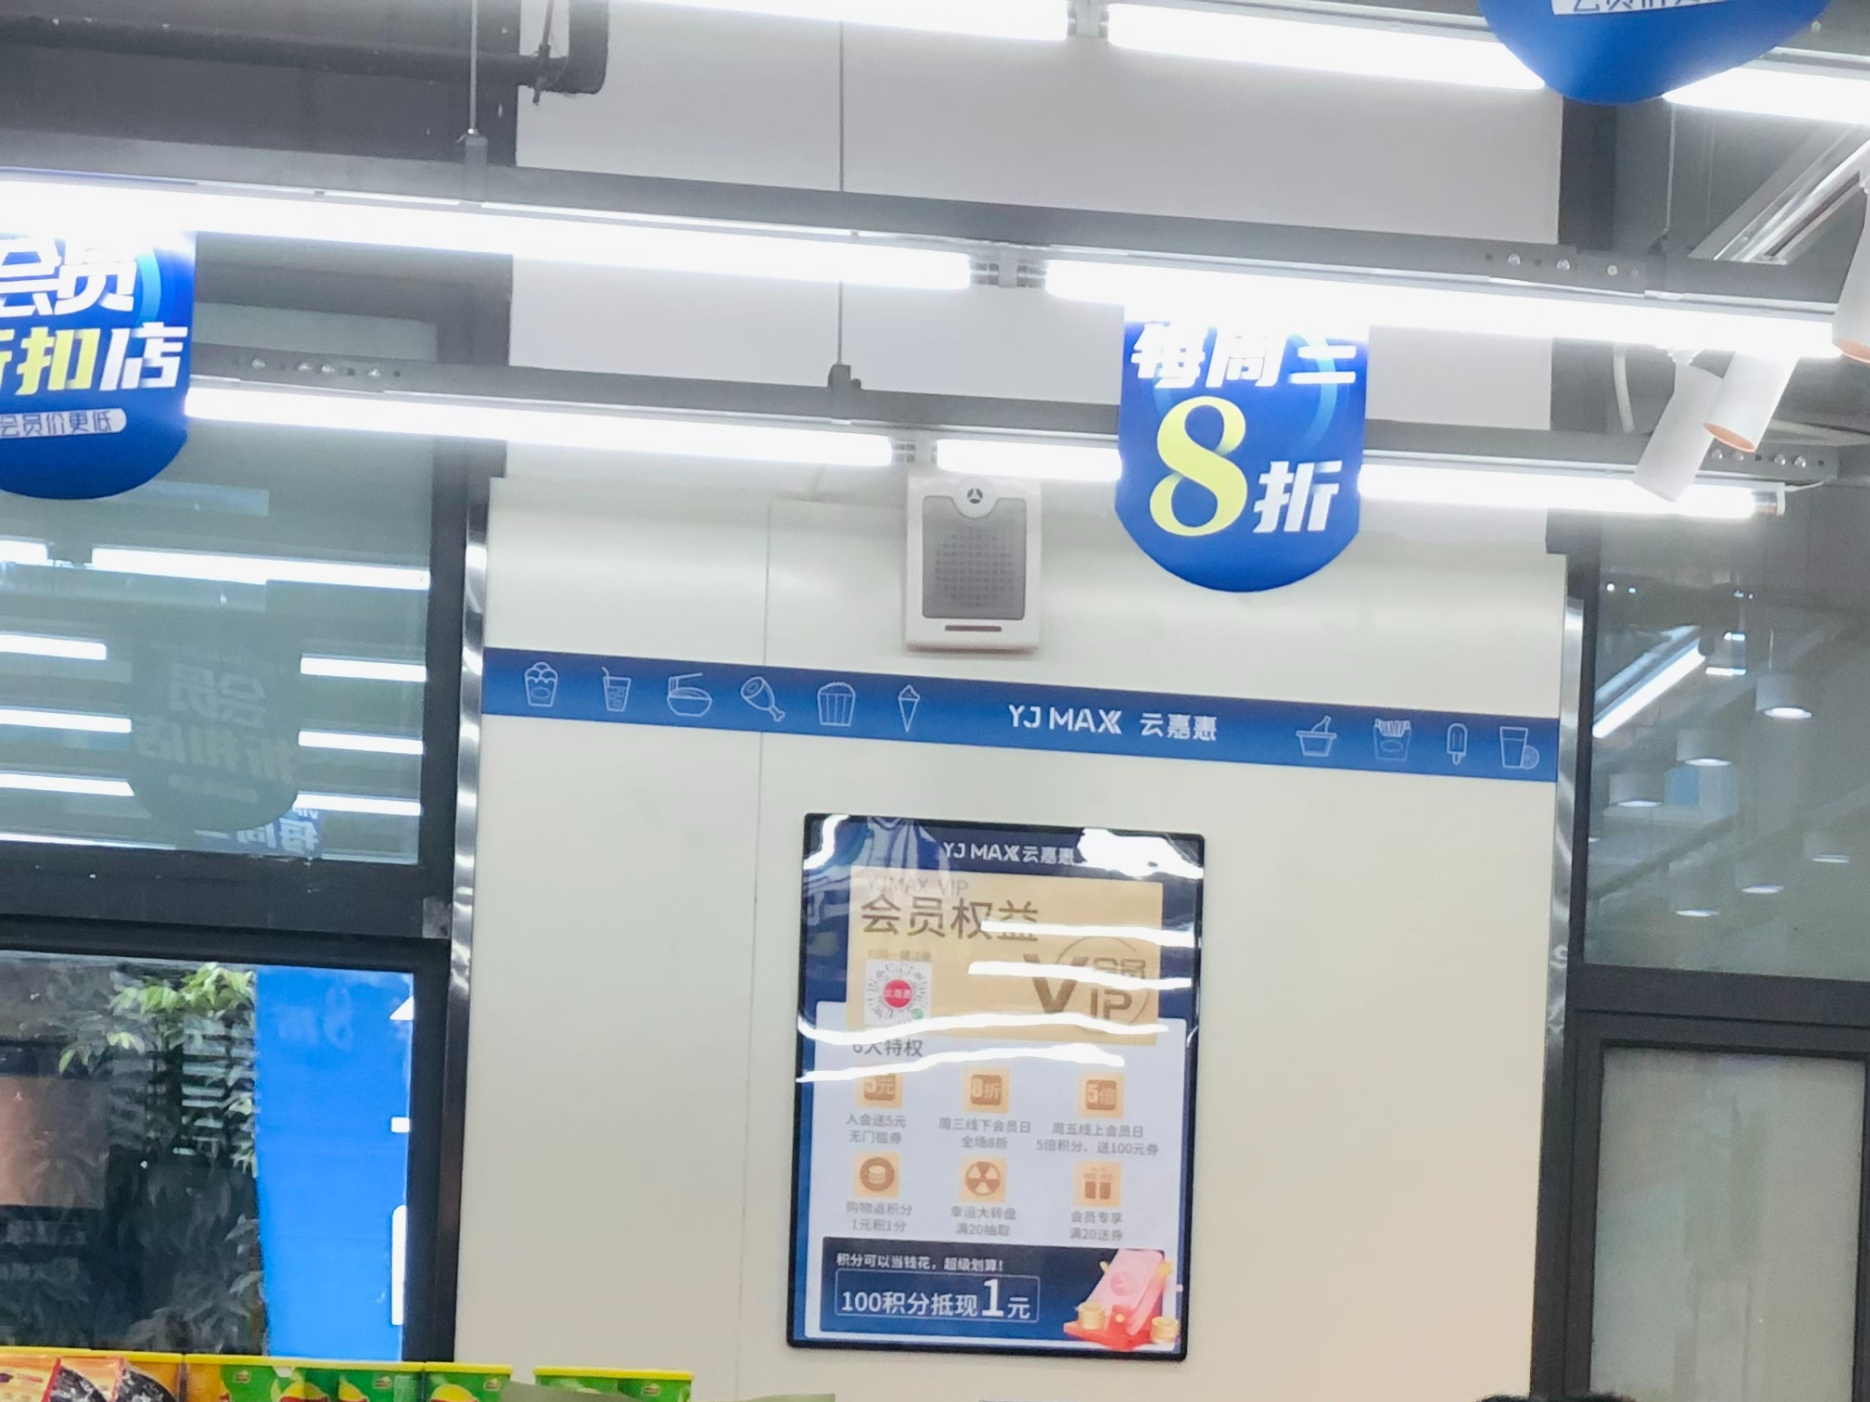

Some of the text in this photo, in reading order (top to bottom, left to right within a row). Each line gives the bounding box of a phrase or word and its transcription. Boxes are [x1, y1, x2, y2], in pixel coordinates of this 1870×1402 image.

[1149, 395, 1343, 537] 8折
[860, 893, 1039, 942] 会员权益
[938, 1117, 1031, 1134] 周三线下会员日
